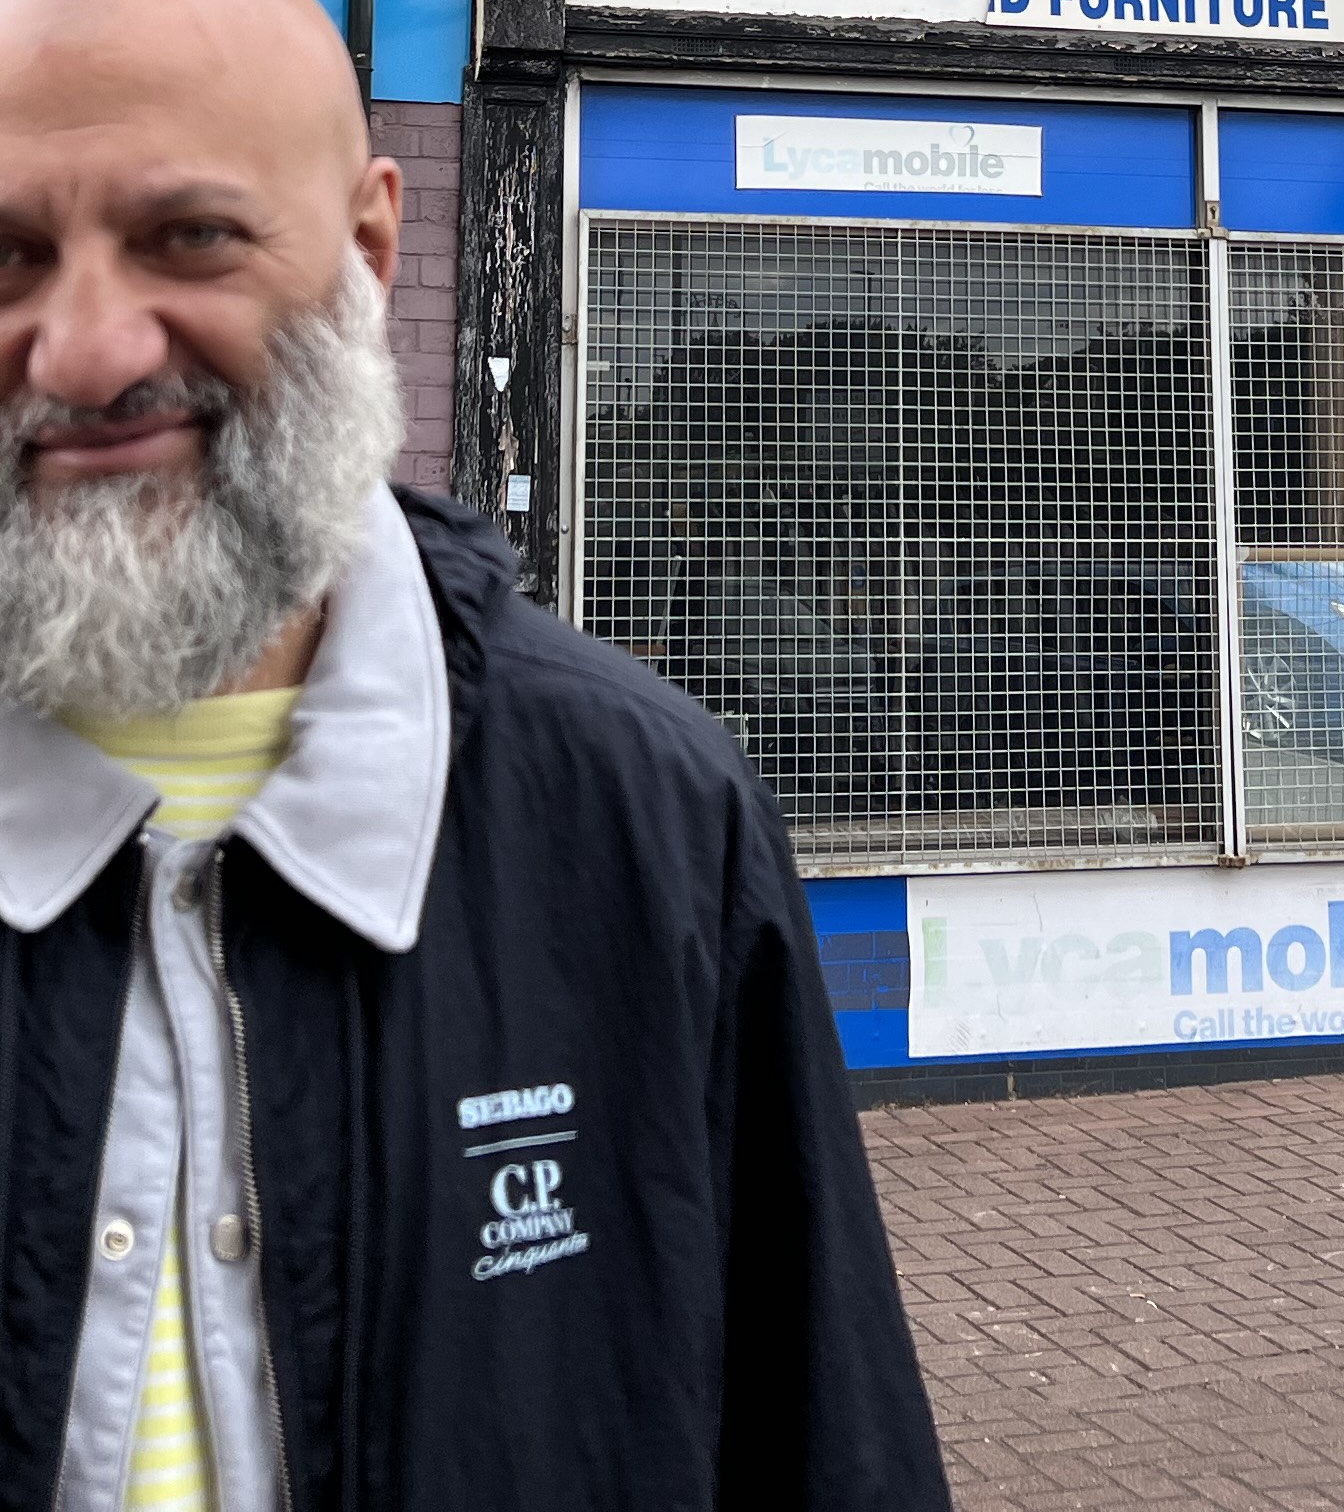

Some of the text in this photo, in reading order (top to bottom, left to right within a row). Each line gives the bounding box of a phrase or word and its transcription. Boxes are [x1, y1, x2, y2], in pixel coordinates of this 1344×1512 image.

[762, 137, 1005, 180] Lycamobile
[1173, 1008, 1235, 1042] Call
[1242, 1006, 1296, 1036] the
[456, 1082, 575, 1129] SEBAGO
